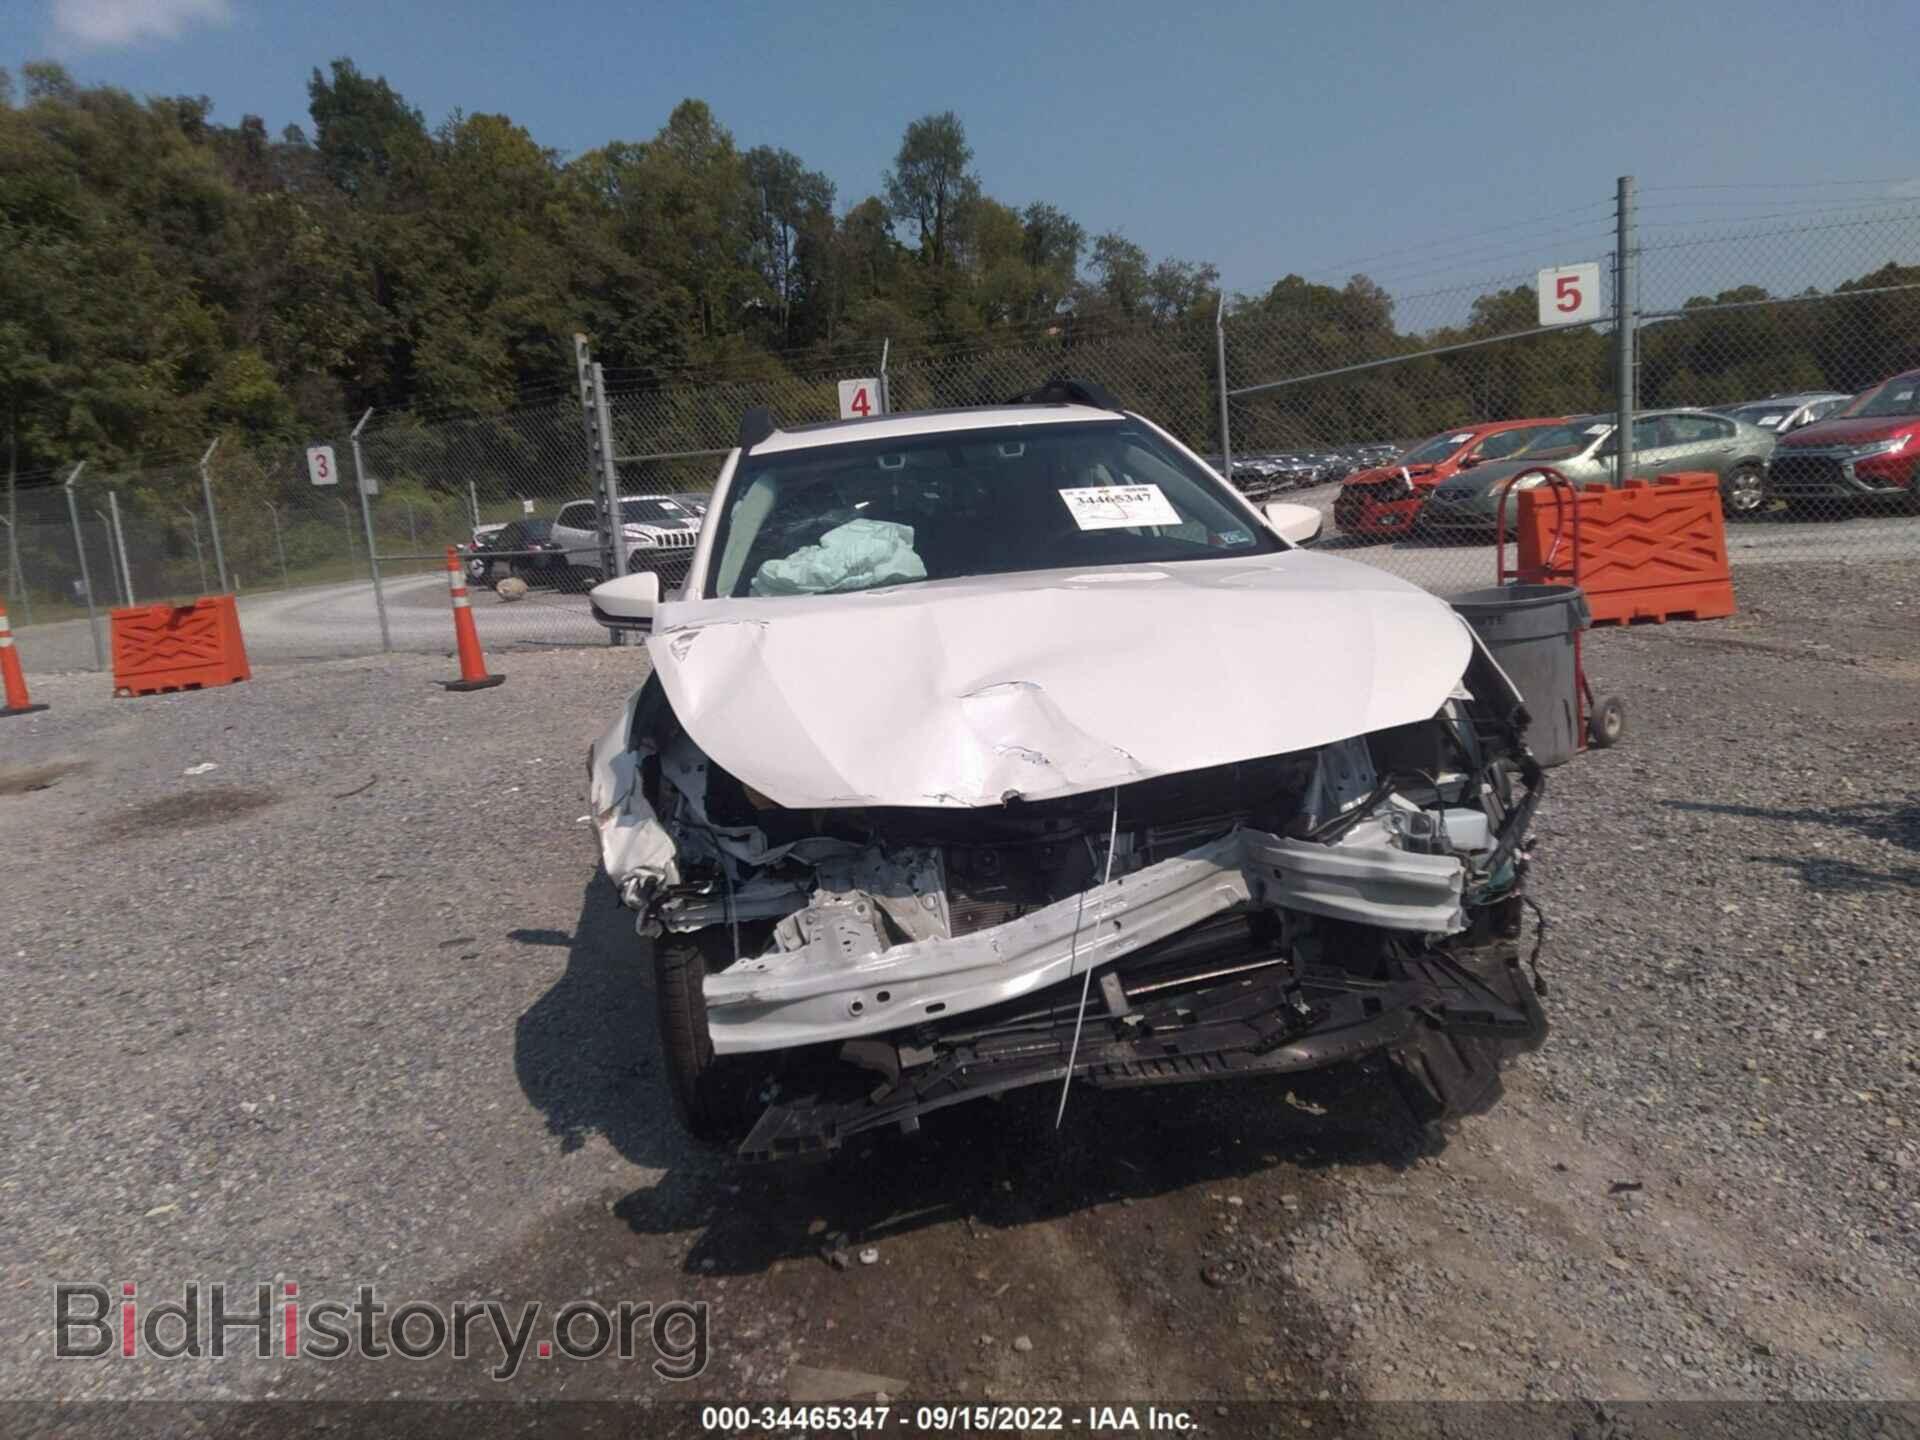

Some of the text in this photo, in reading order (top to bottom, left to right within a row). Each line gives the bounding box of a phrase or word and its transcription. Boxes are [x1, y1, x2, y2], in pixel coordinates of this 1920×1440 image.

[1556, 275, 1582, 313] 5
[851, 388, 871, 416] 4
[315, 454, 328, 478] 3
[1076, 493, 1151, 505] 34465347
